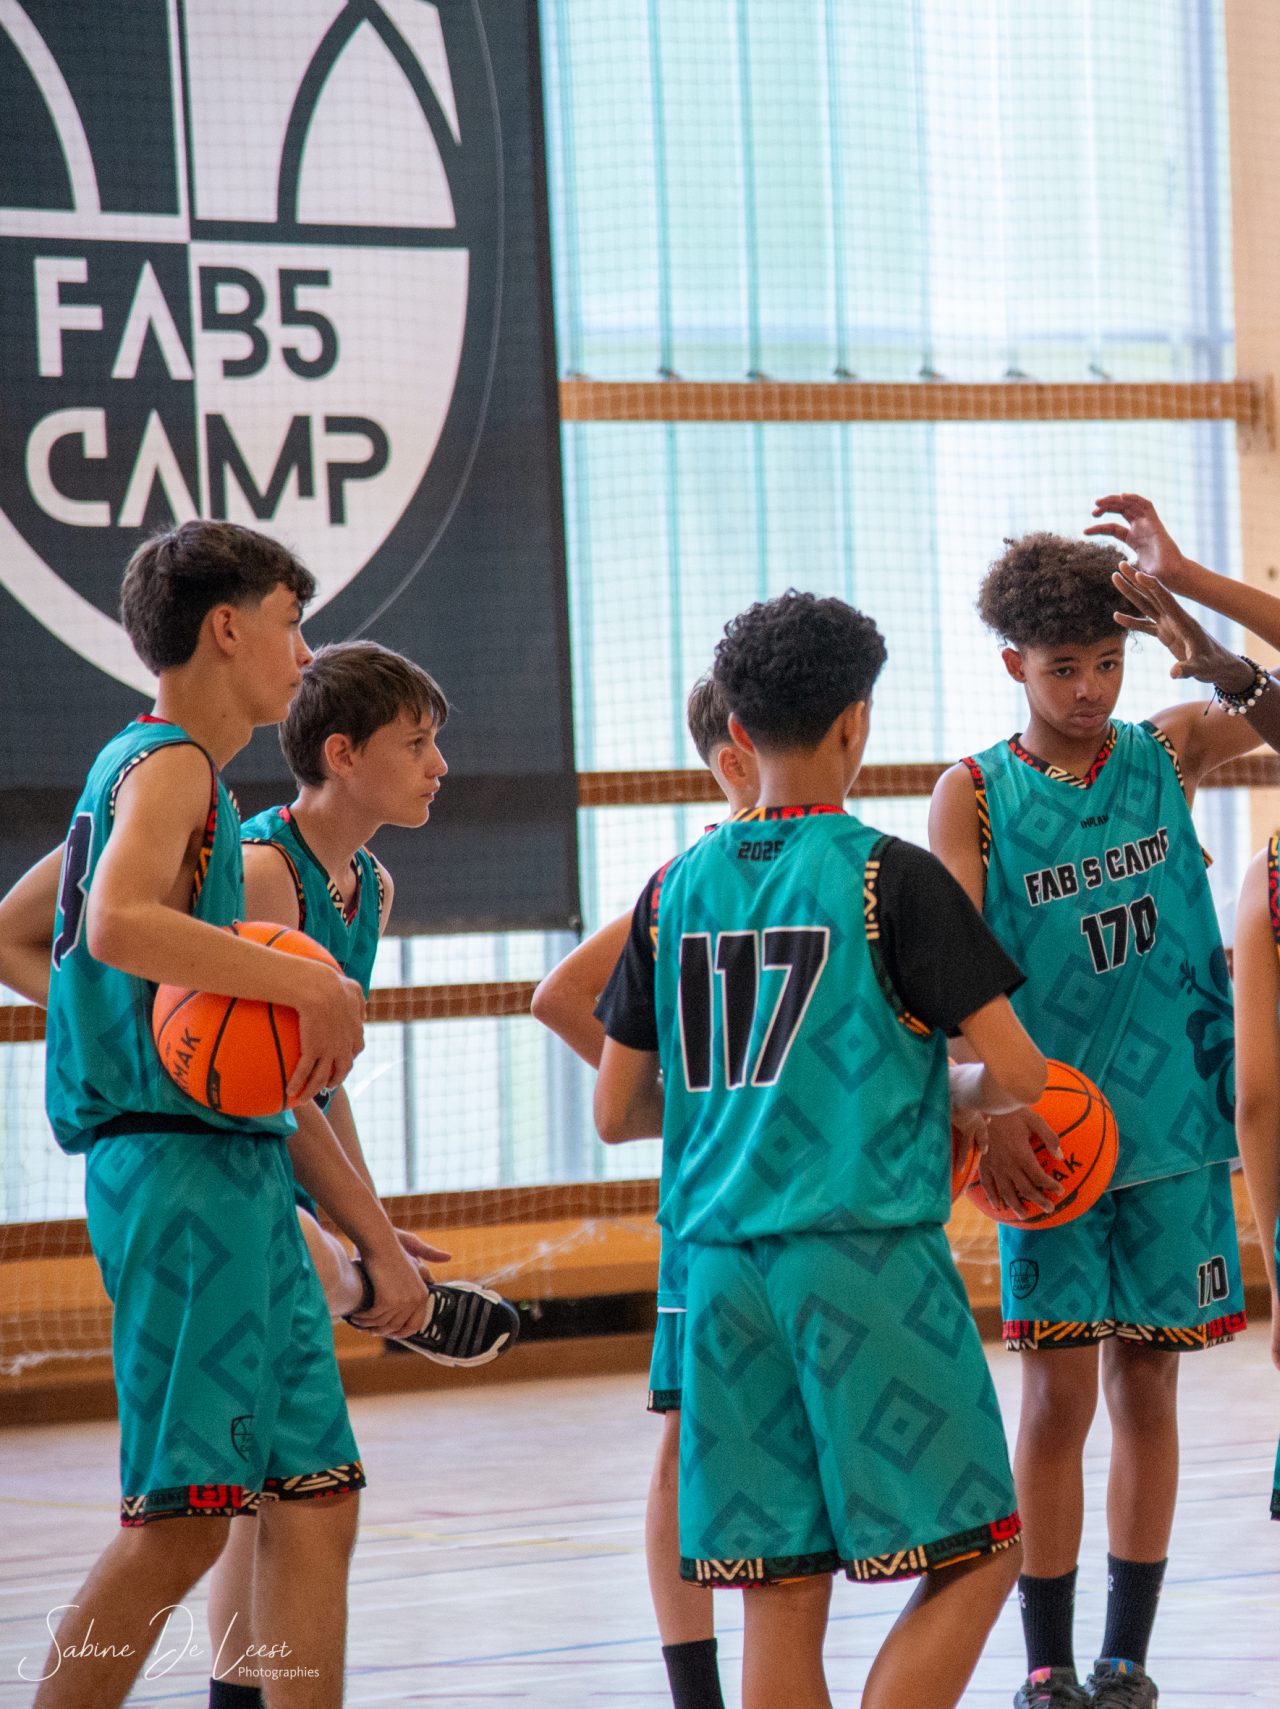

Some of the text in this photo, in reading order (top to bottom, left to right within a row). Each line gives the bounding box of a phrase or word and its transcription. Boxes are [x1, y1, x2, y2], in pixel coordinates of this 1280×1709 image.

[34, 256, 340, 381] FAB5
[25, 406, 392, 528] CAMP
[737, 840, 785, 862] 2025
[1024, 863, 1079, 907] FAB
[1105, 826, 1169, 882] CAMP
[1081, 893, 1158, 974] 170
[679, 926, 830, 1092] 117
